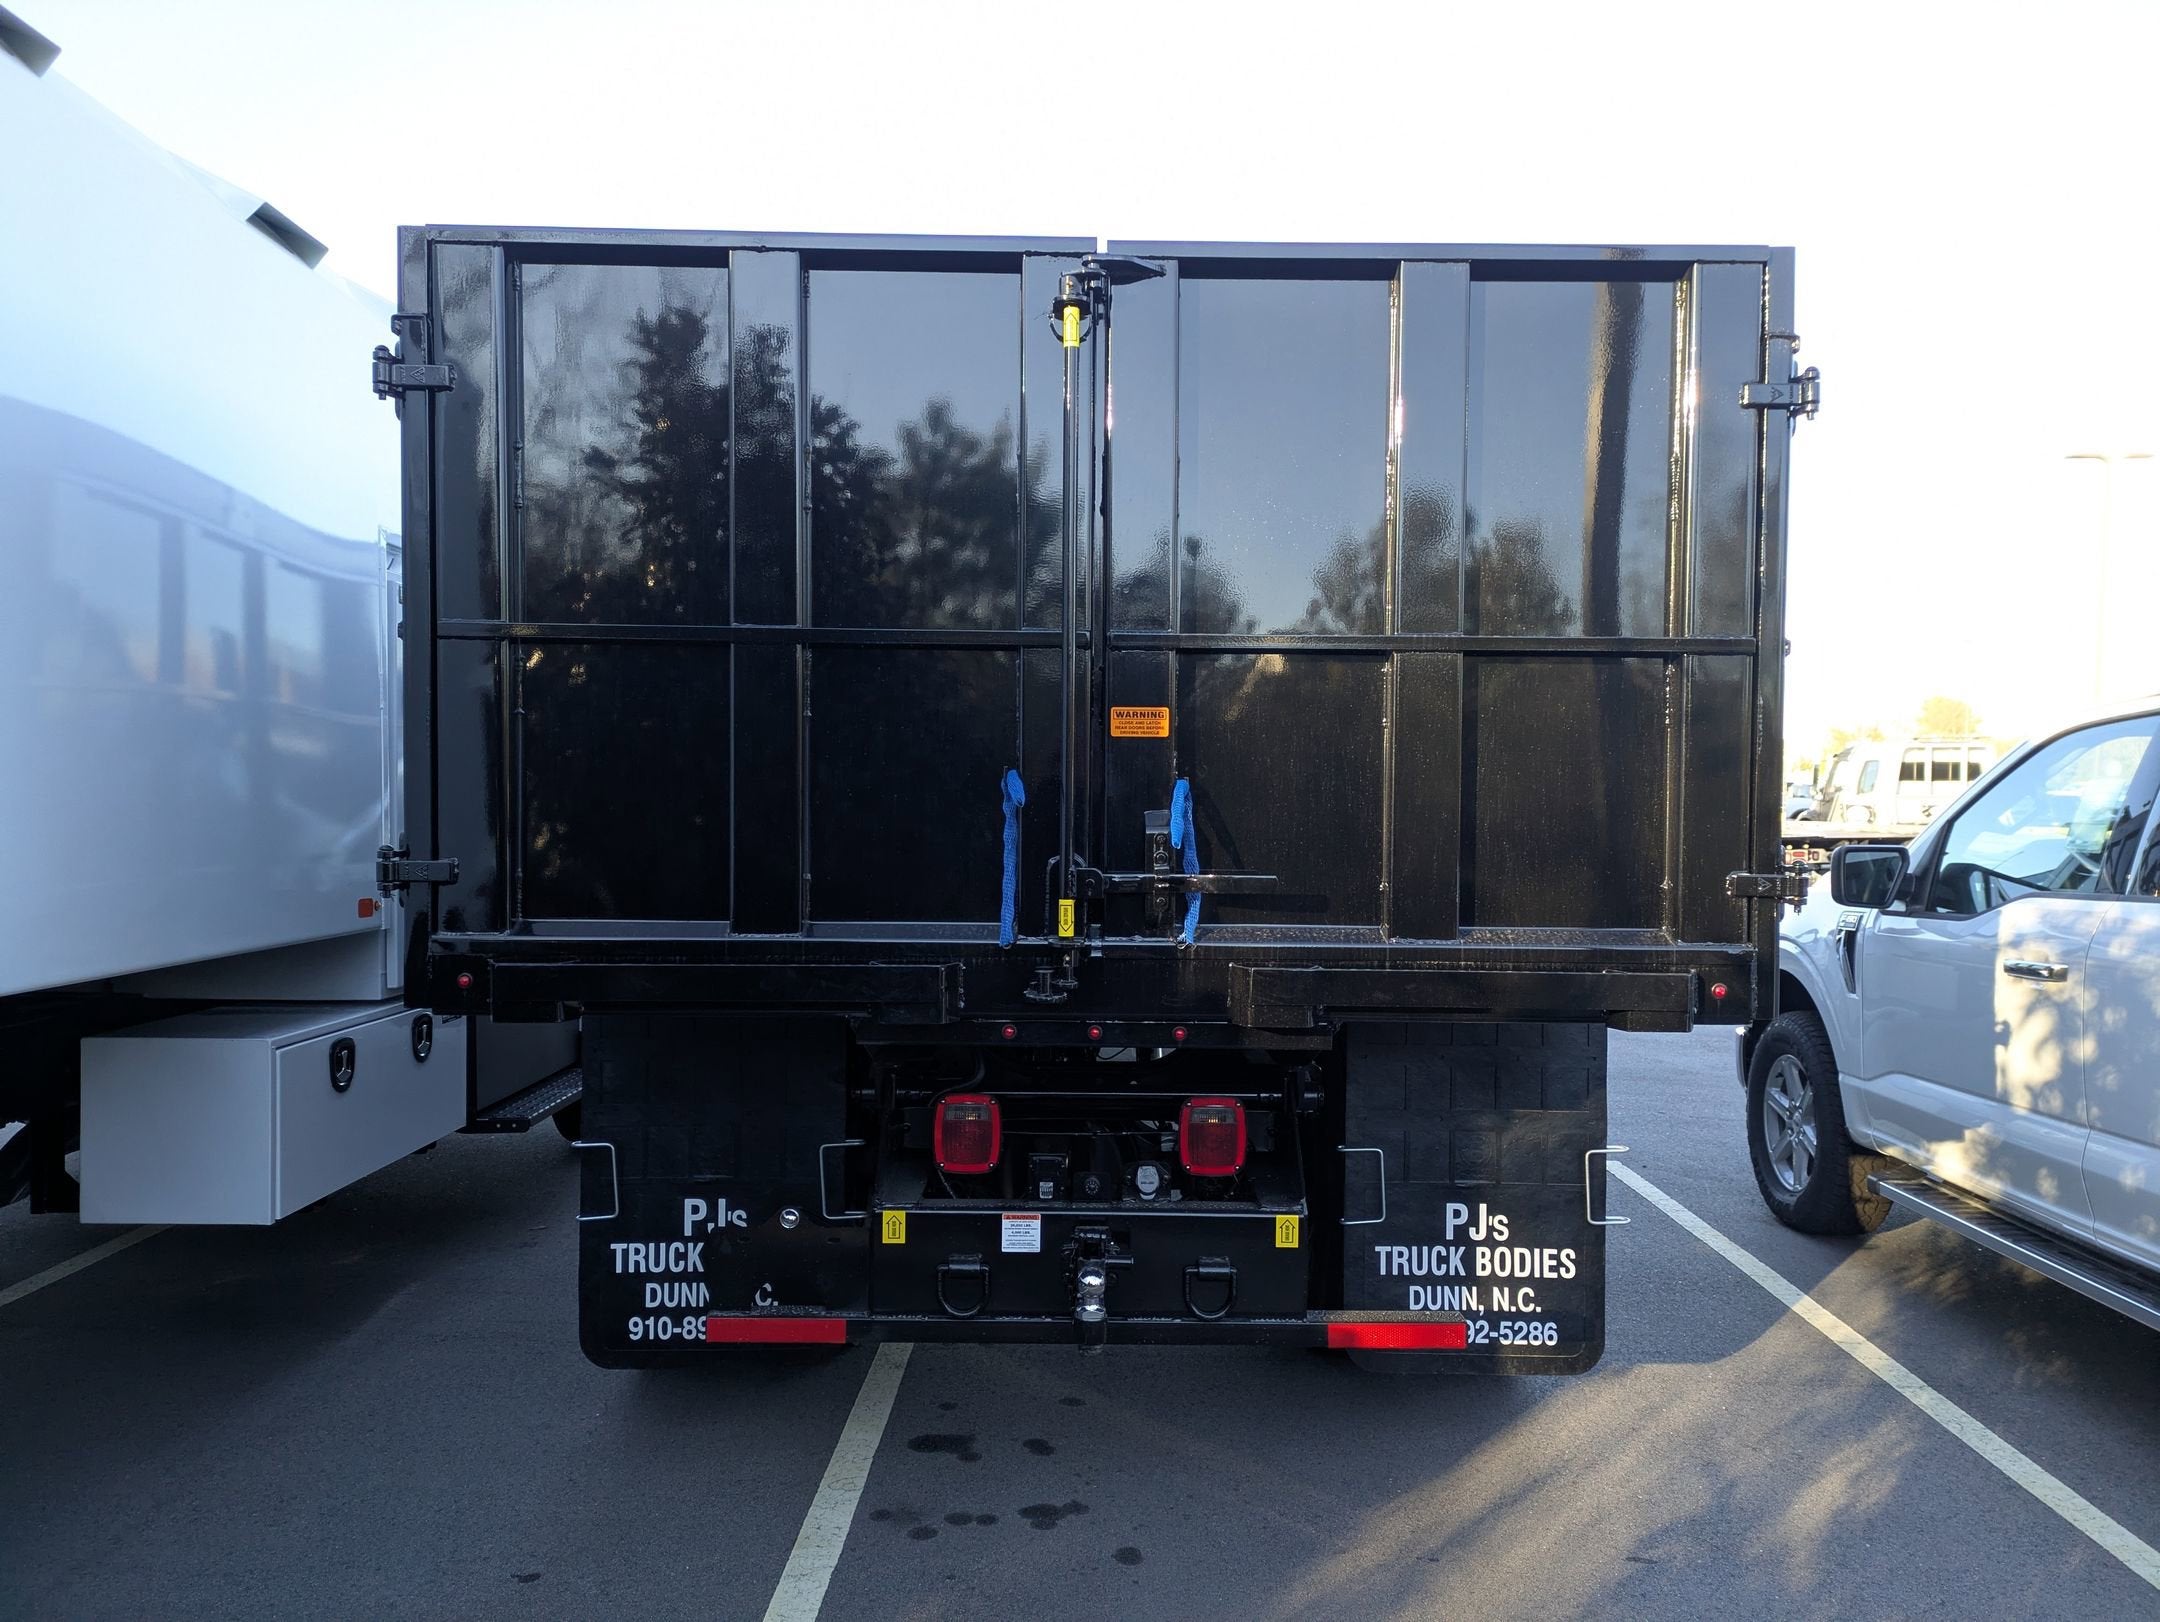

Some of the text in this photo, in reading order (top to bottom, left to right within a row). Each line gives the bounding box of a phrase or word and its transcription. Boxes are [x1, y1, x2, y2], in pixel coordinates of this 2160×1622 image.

[1445, 1202, 1509, 1241] PJ's
[610, 1241, 705, 1274] TRUCK
[1375, 1245, 1576, 1279] TRUCK BODIES
[1409, 1286, 1542, 1316] DUNN, N.C.
